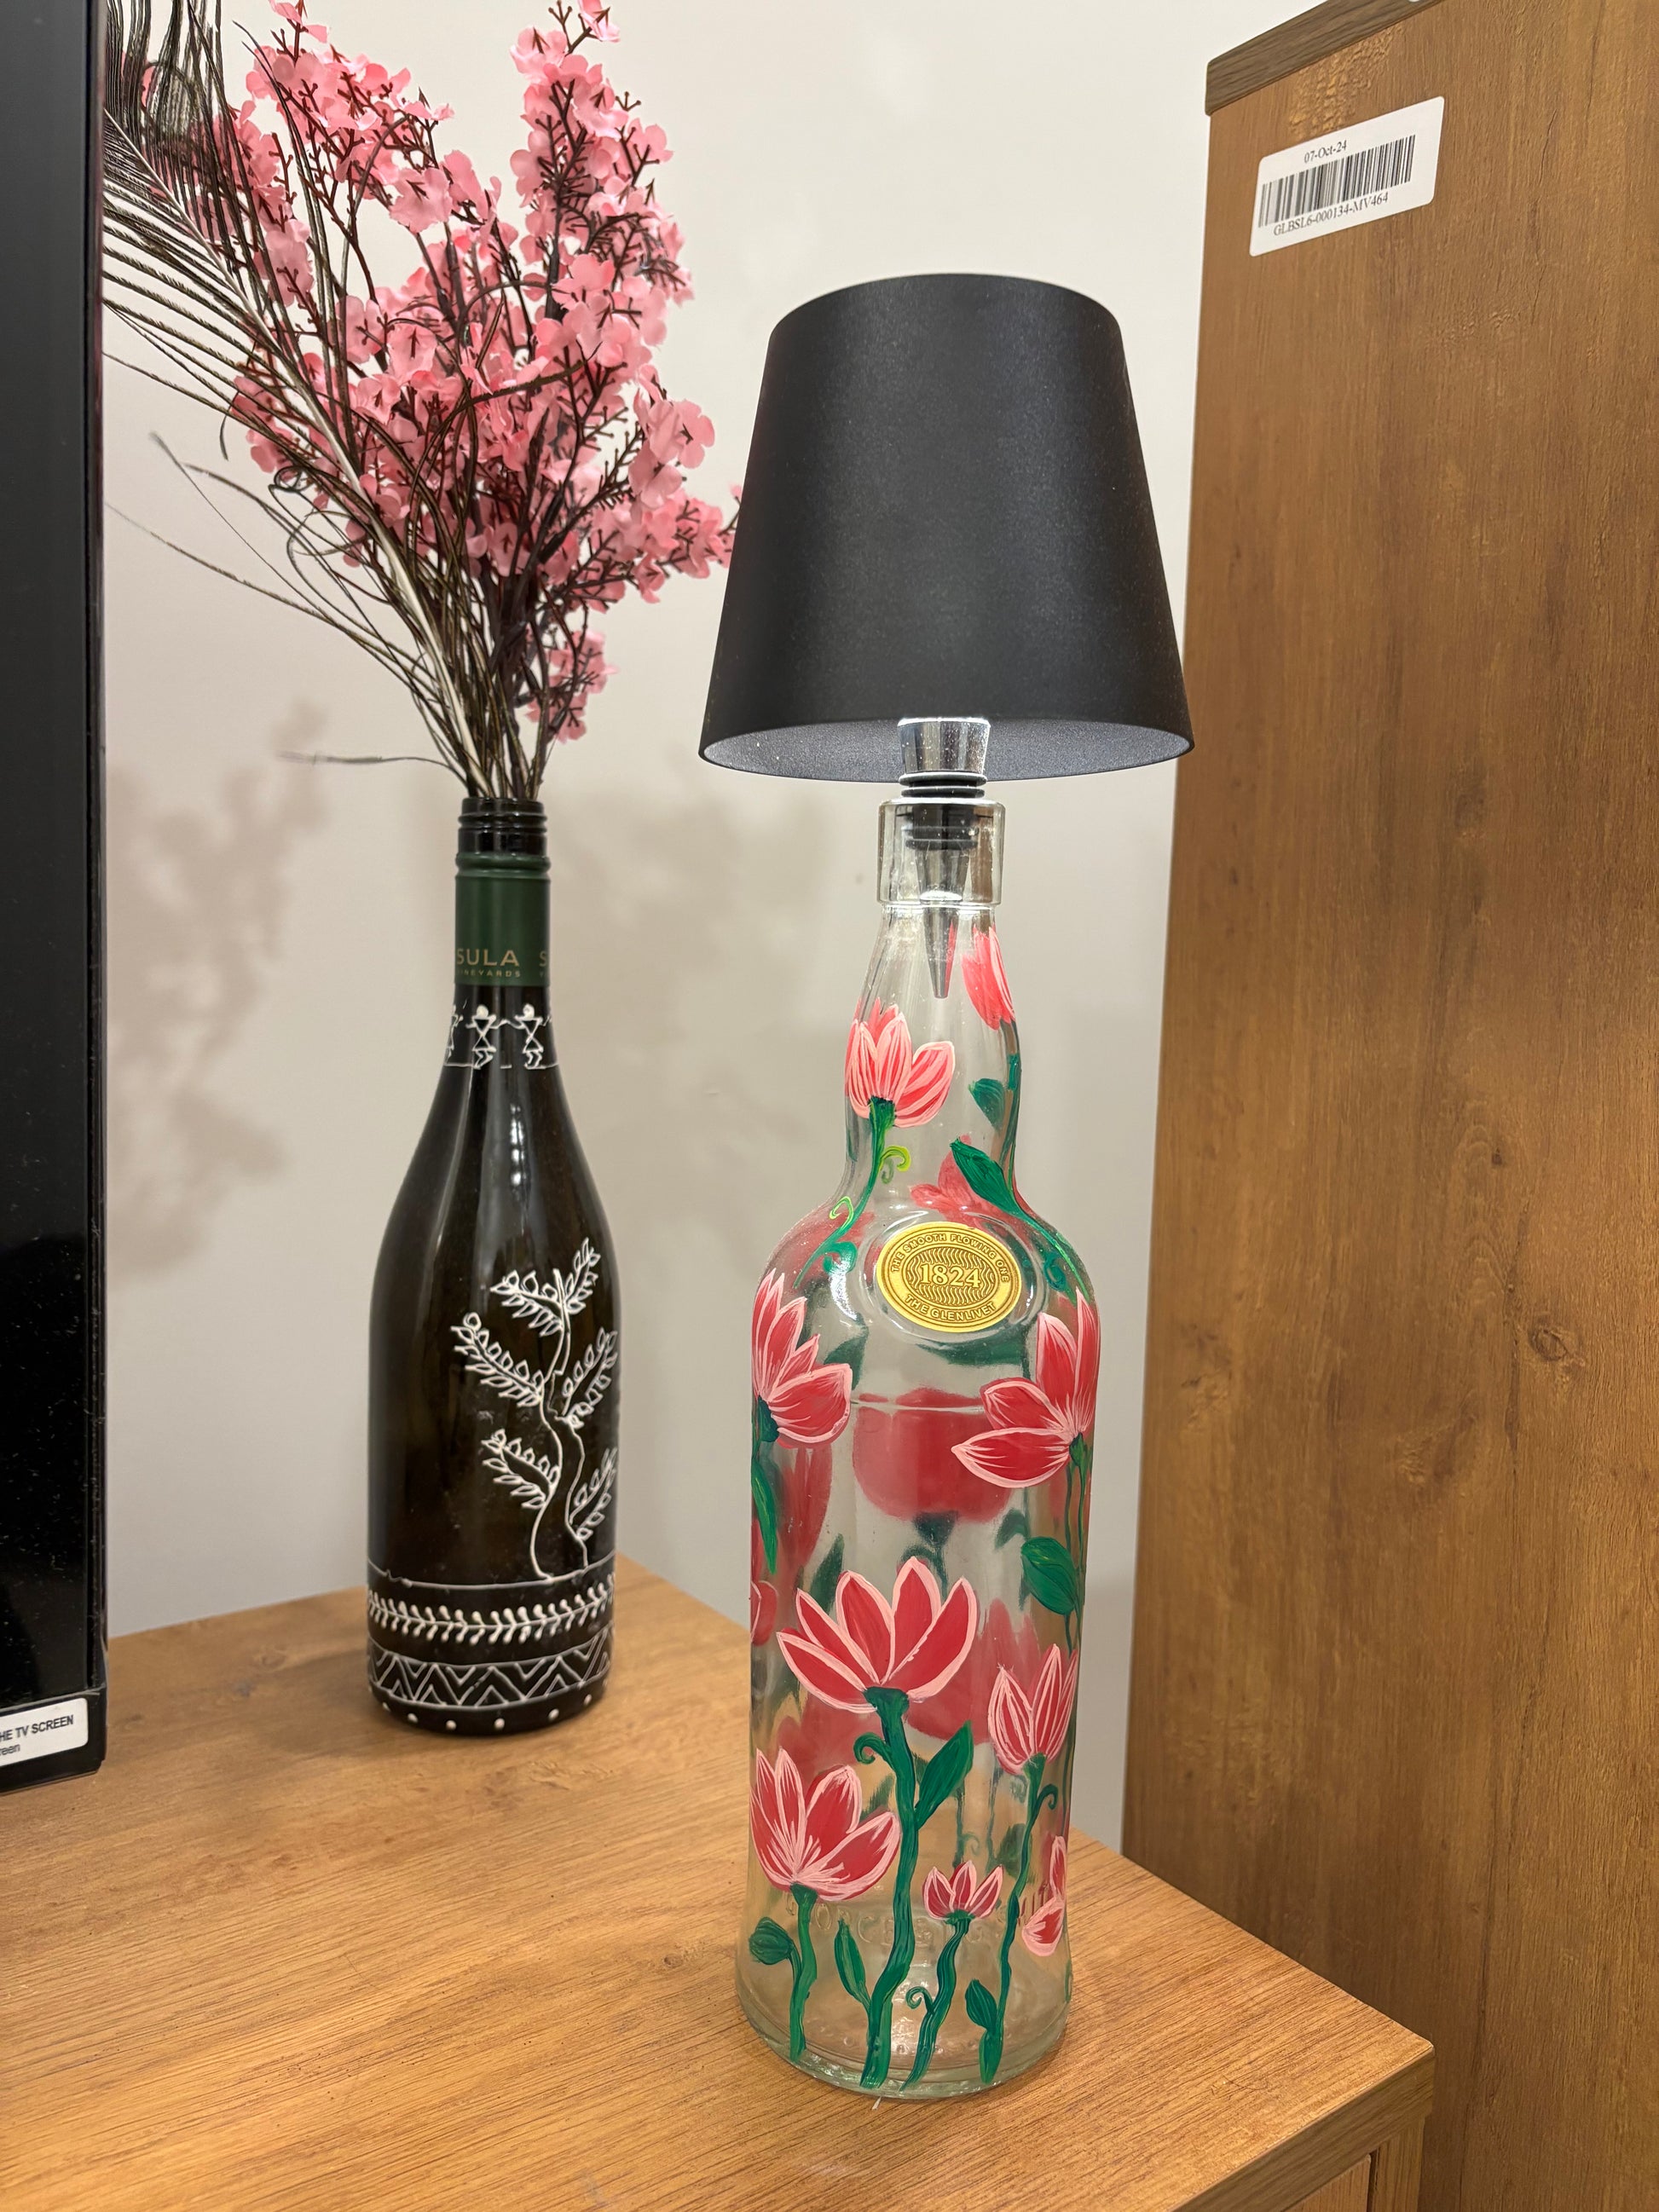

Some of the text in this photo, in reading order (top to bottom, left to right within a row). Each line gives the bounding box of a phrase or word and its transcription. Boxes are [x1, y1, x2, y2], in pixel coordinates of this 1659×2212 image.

[1304, 140, 1347, 163] 07-Oct-24
[1274, 192, 1389, 236] GLBSL6-000134-MV464
[456, 949, 520, 967] SULA
[891, 1233, 1010, 1283] THE SMOOTH FLOWING ONE
[920, 1263, 981, 1288] 1824
[905, 1294, 997, 1321] THE GLENLIVET
[15, 1725, 29, 1738] TV
[32, 1714, 74, 1735] SCREEN
